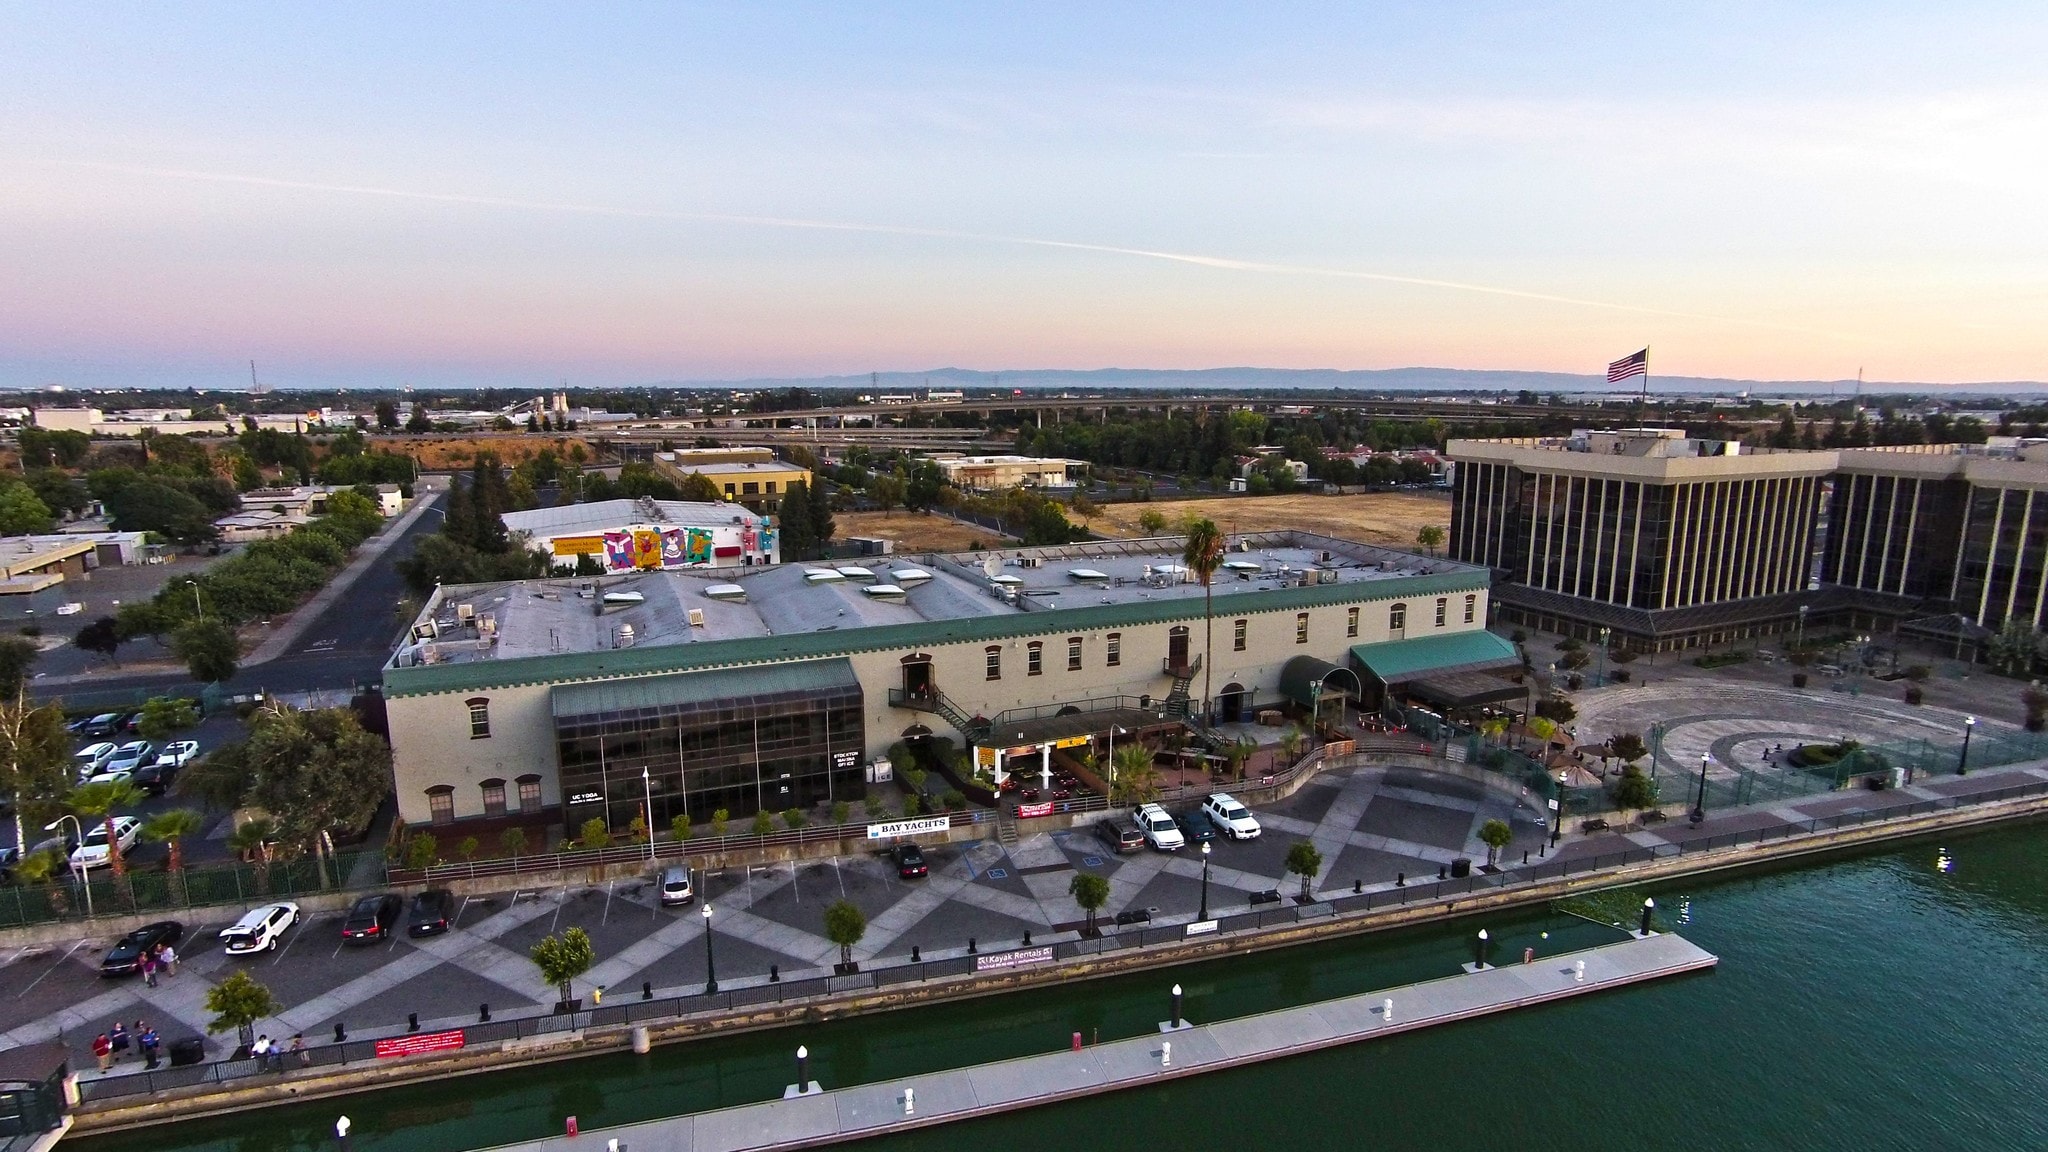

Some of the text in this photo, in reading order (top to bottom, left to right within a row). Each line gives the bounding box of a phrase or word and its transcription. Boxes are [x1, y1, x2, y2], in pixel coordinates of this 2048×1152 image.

[834, 751, 859, 759] STOCKTON
[881, 818, 946, 833] BAY YACHTS
[988, 953, 1013, 964] Kayak
[1014, 949, 1042, 960] Rentals
